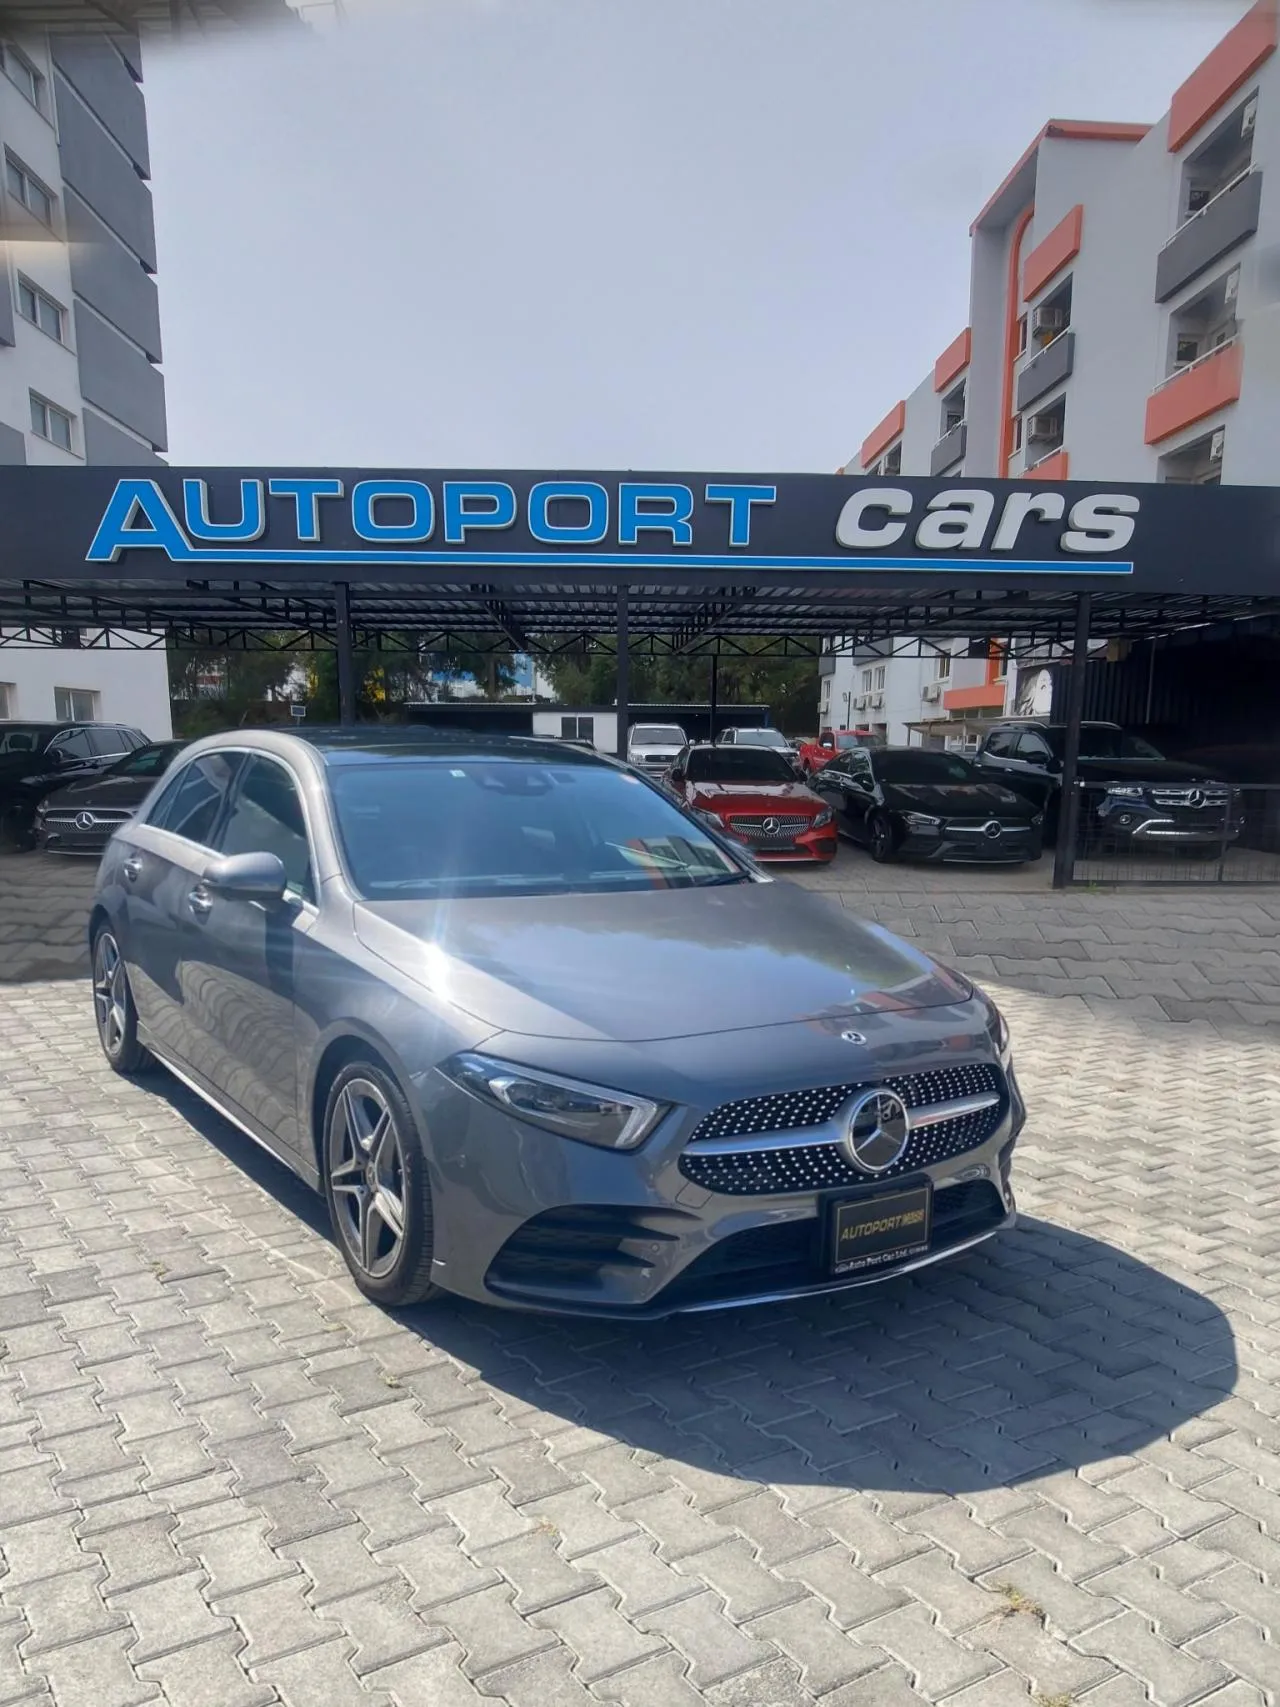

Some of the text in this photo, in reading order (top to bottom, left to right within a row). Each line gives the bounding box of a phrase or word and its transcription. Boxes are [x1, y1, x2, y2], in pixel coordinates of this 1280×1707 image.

[85, 478, 1141, 562] AUTOPORT cars
[840, 1215, 902, 1241] AUTOPORT
[849, 1259, 866, 1269] Auto
[866, 1255, 882, 1267] Port
